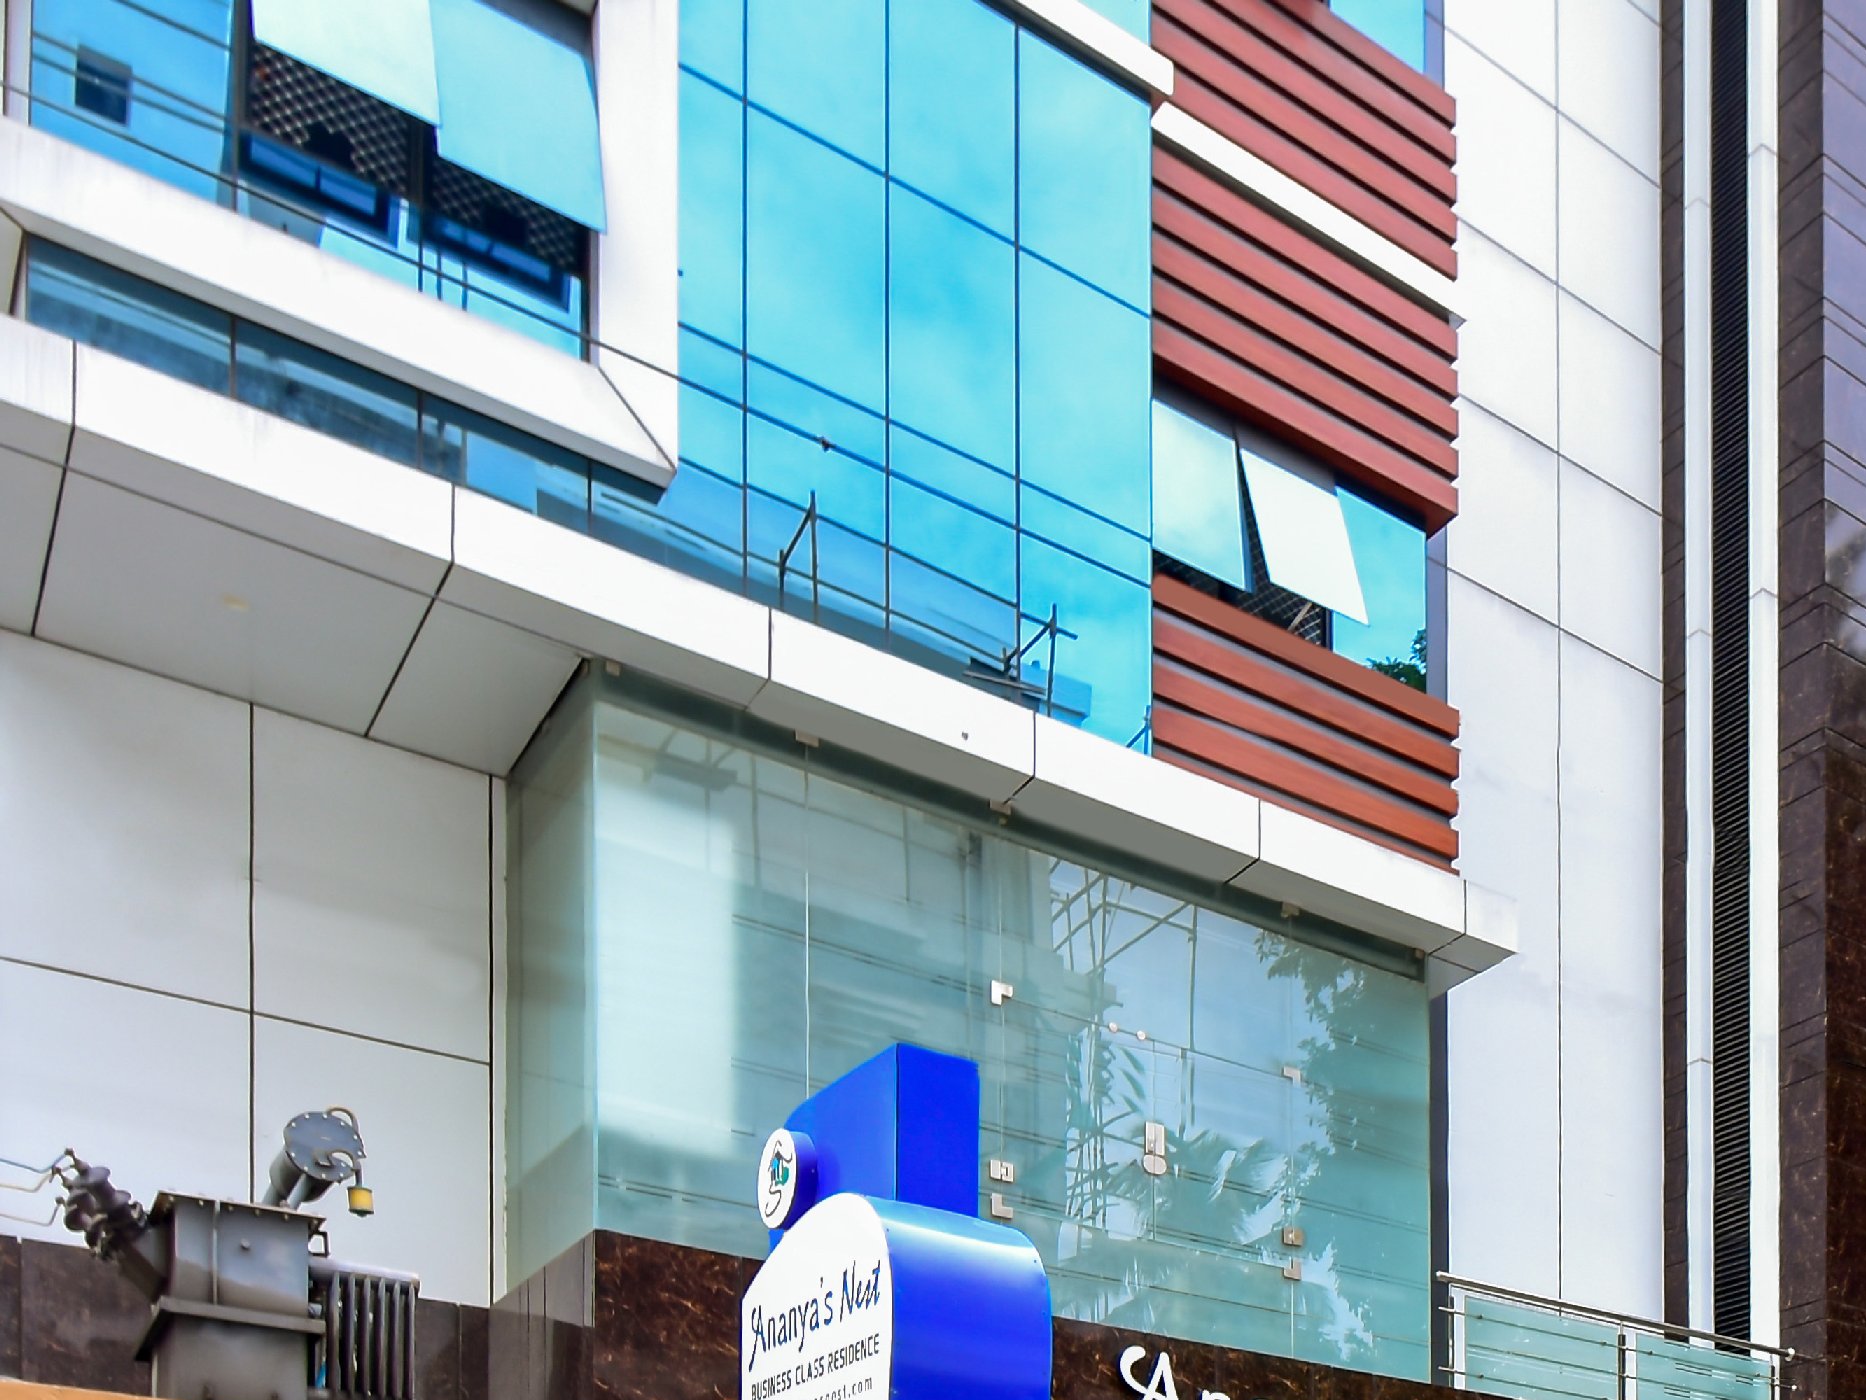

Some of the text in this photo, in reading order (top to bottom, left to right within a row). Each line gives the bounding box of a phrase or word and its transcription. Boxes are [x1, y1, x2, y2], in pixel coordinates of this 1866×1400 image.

[749, 1260, 880, 1372] Ananya's Nest
[796, 1356, 824, 1385] CLASS
[828, 1333, 879, 1373] RESIDENCE
